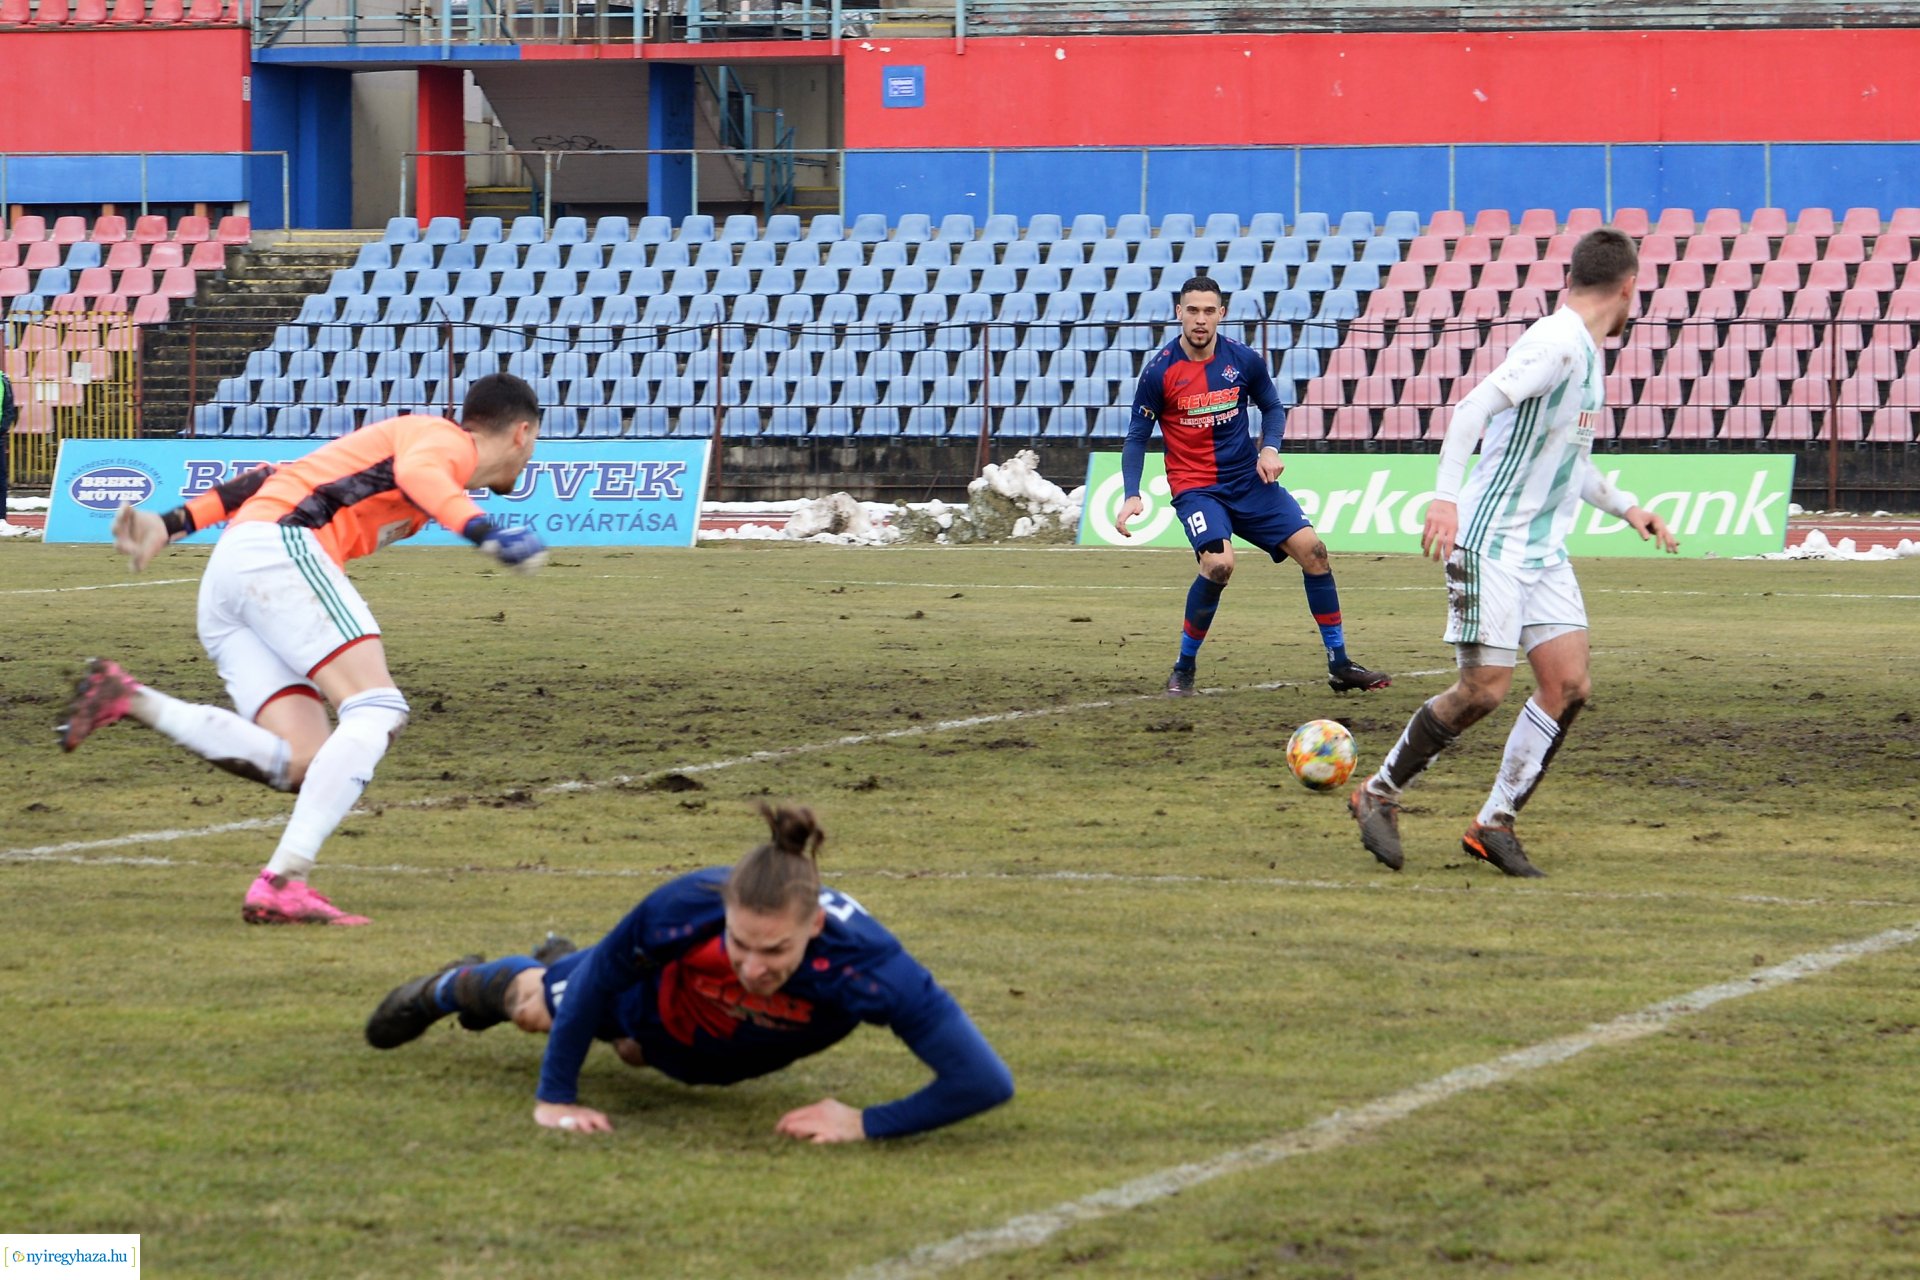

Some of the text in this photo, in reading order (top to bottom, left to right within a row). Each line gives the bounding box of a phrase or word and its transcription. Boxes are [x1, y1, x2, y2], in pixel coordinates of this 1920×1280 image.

[80, 476, 146, 488] BREKK
[546, 508, 679, 533] GYÁRTÁSA
[1187, 511, 1208, 538] 19
